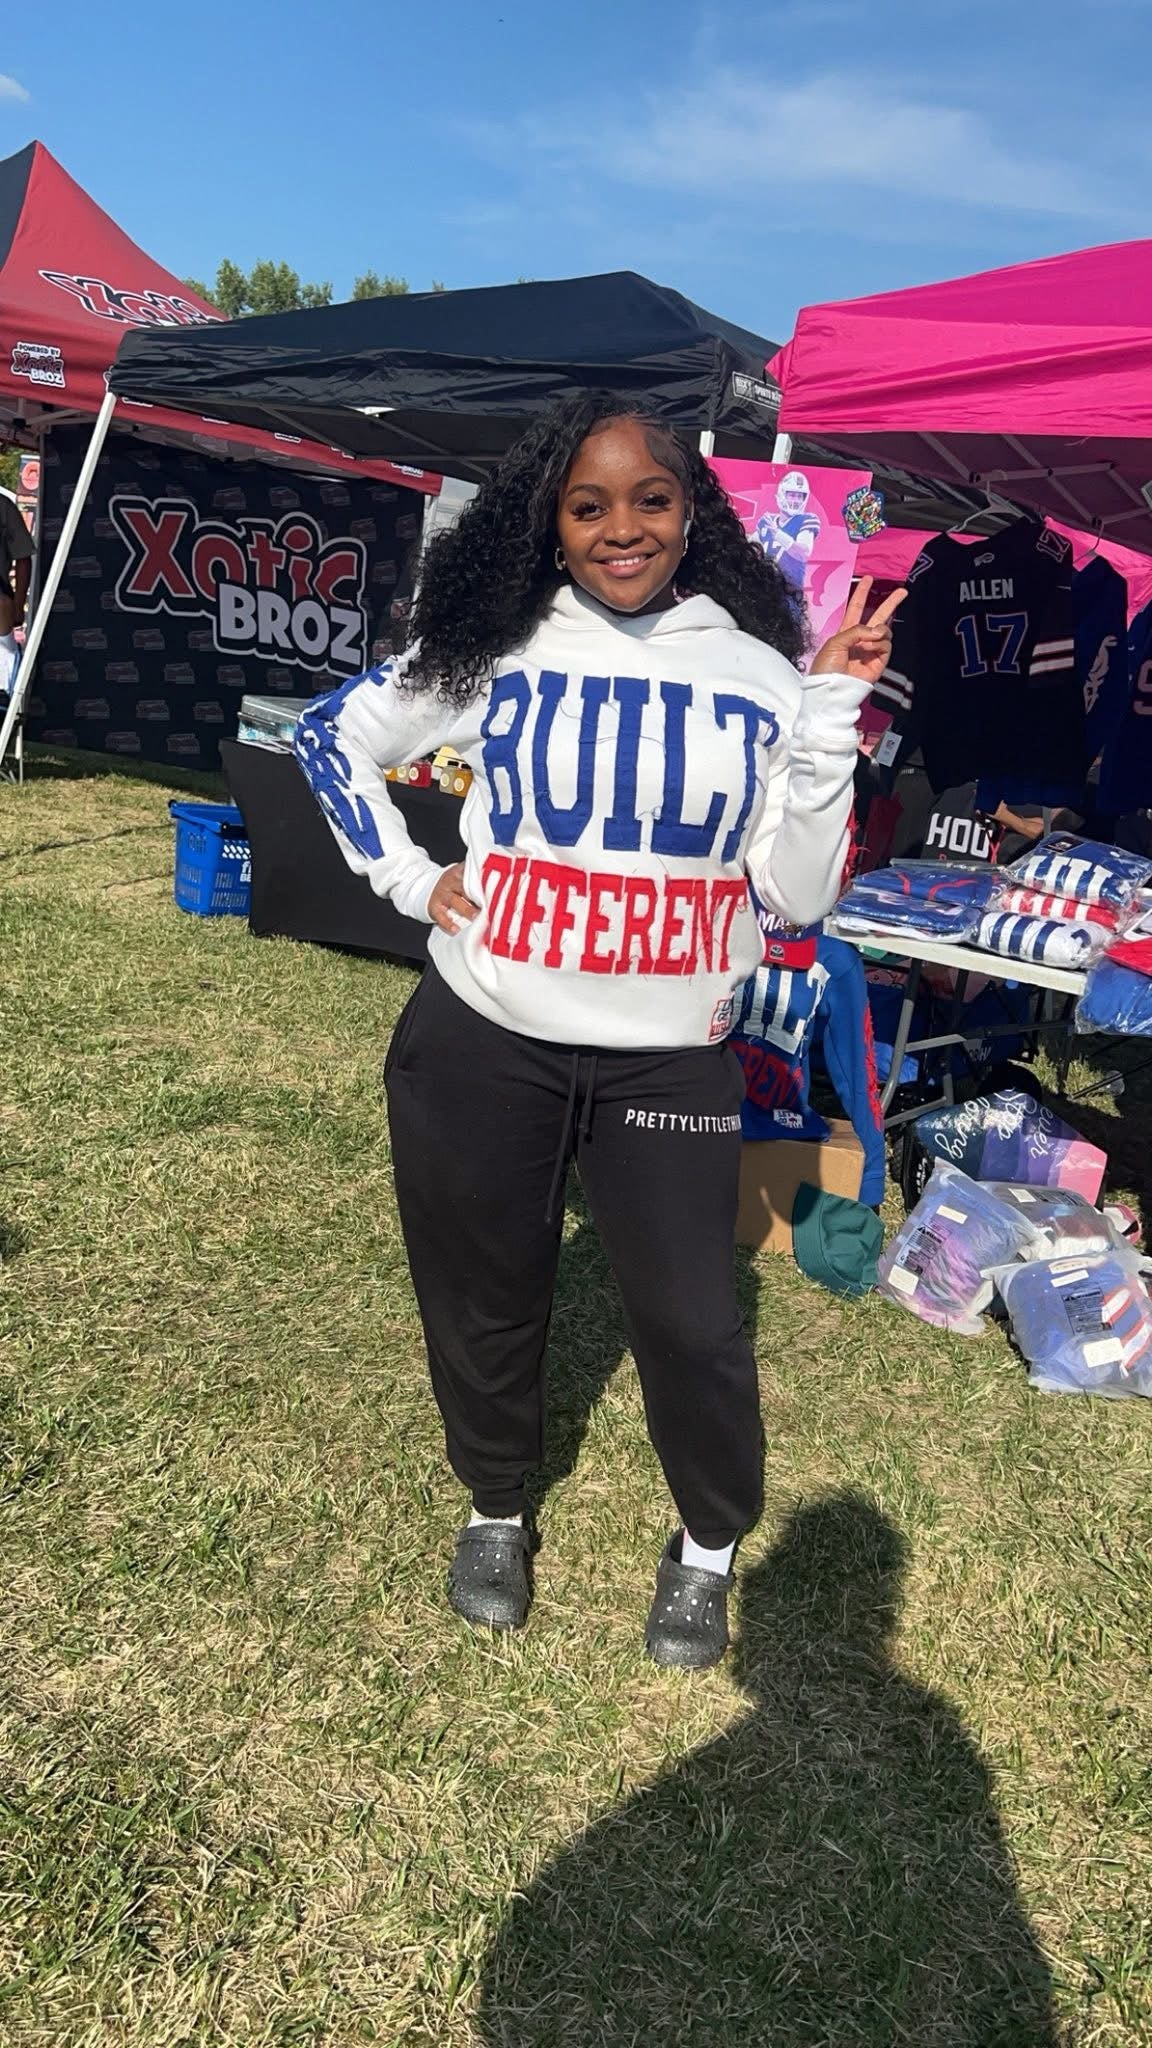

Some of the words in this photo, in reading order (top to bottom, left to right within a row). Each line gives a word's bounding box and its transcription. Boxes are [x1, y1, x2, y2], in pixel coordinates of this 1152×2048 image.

[13, 351, 63, 373] Xotic
[18, 344, 49, 355] POWERED
[31, 368, 63, 384] BROZ
[119, 508, 358, 607] Xotic
[959, 578, 1015, 603] ALLEN
[218, 582, 361, 667] BROZ
[954, 611, 1029, 678] 17
[480, 670, 780, 864] BUILT
[481, 852, 746, 976] DIFFERENT
